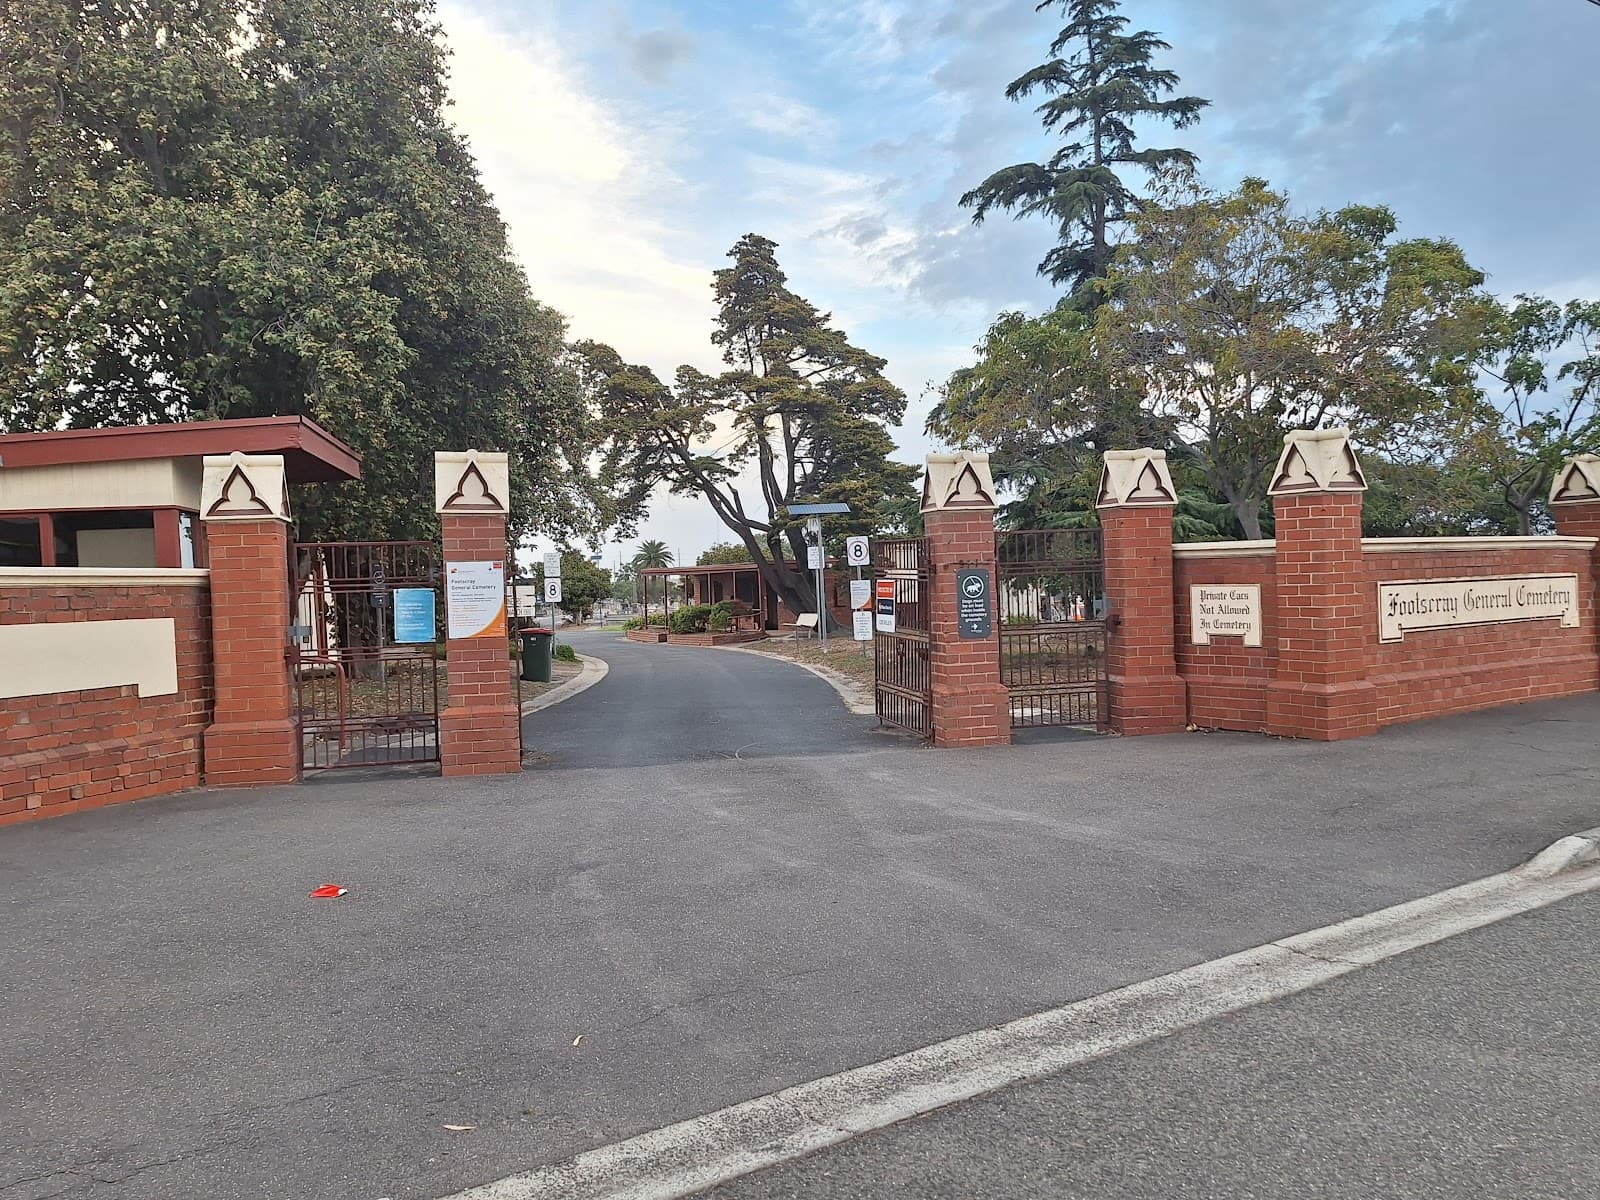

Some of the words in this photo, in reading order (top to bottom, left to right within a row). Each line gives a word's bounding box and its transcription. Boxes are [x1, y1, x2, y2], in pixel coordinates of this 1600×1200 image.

[854, 544, 863, 558] 8
[549, 584, 557, 596] 8
[1200, 589, 1227, 603] Private
[1229, 589, 1249, 601] Cars
[1387, 591, 1458, 619] Footscray
[1463, 586, 1512, 611] General
[1516, 584, 1570, 611] Cemetery
[1200, 604, 1214, 615] Not
[1217, 604, 1250, 615] Allowed
[1200, 618, 1211, 629] In
[1213, 618, 1252, 632] Cemetery
